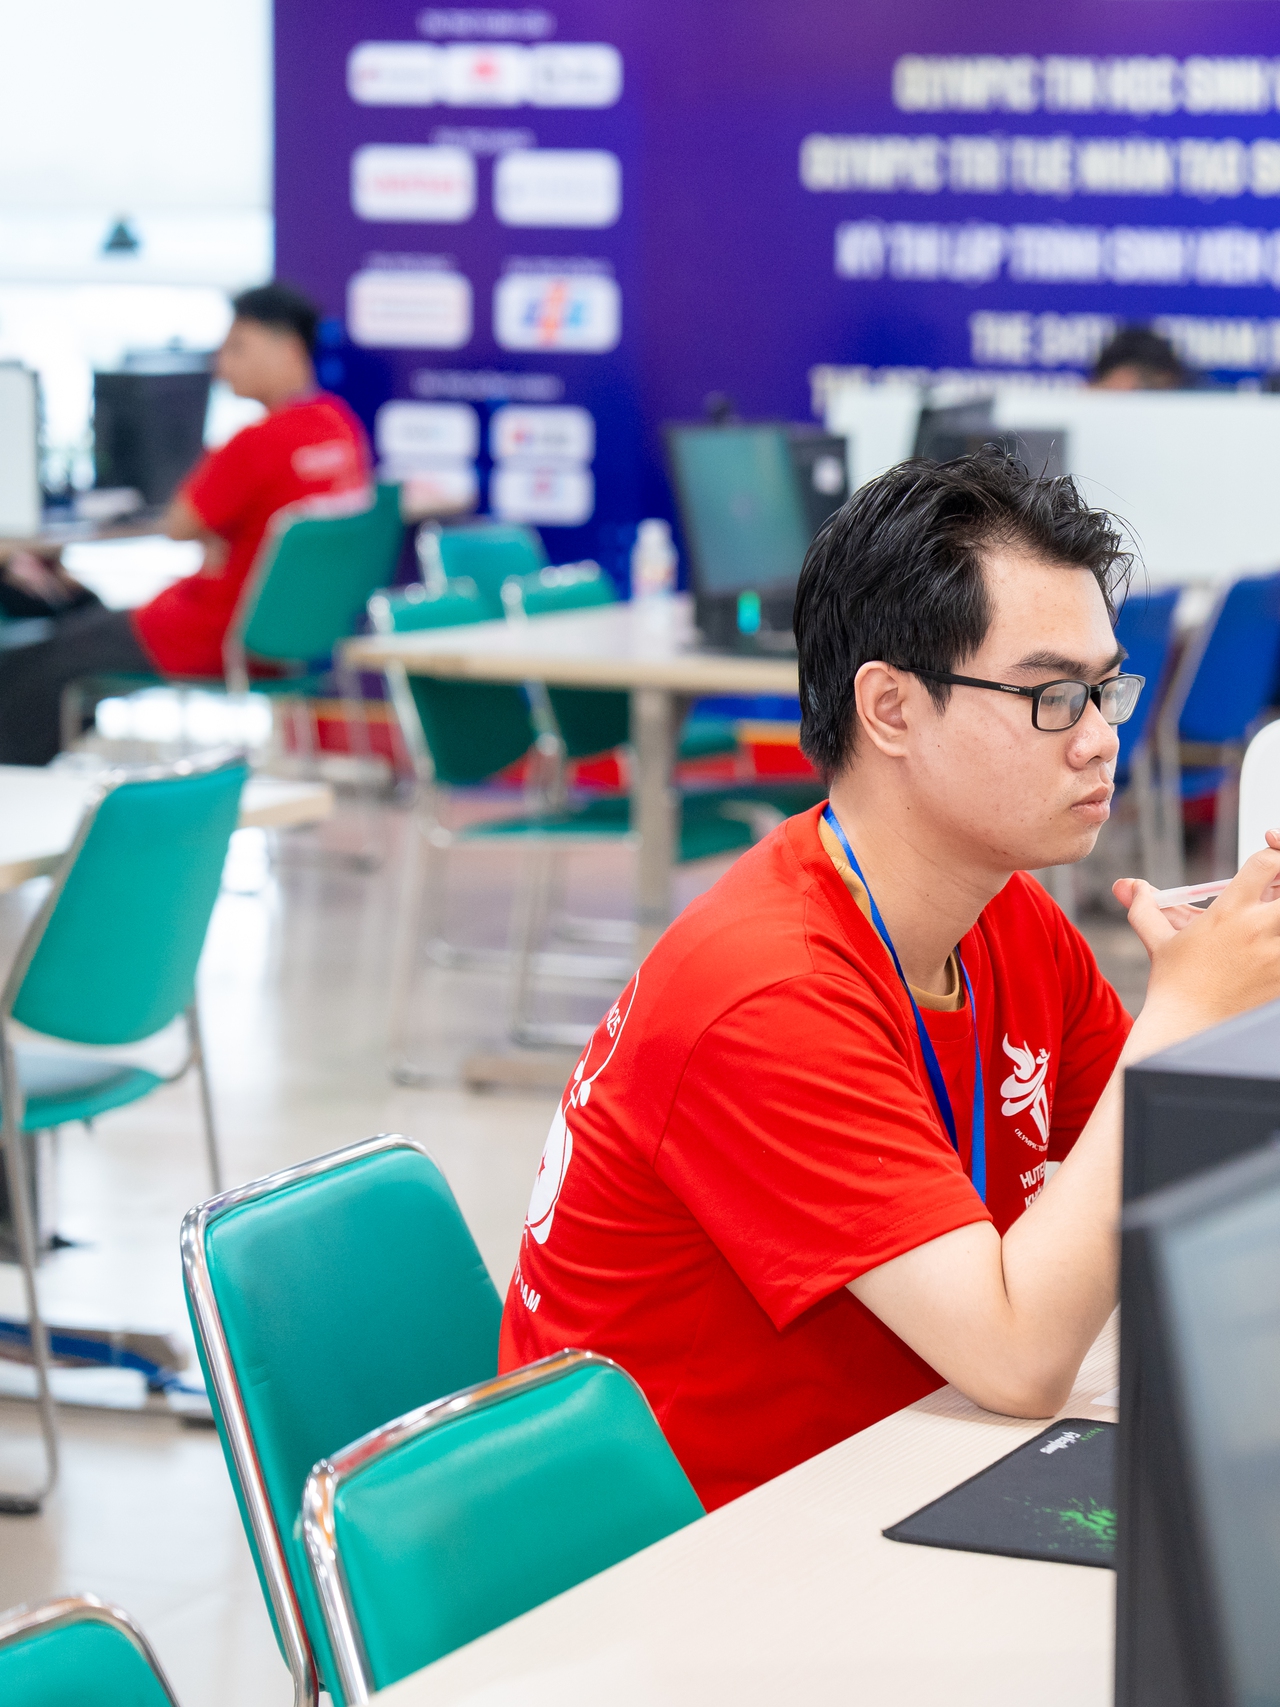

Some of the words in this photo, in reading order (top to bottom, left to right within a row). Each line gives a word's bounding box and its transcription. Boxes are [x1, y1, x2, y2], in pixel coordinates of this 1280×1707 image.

[895, 57, 1039, 109] OLYMPIC
[802, 136, 943, 188] OLYMPIC
[1014, 1128, 1038, 1151] OLYMPIC
